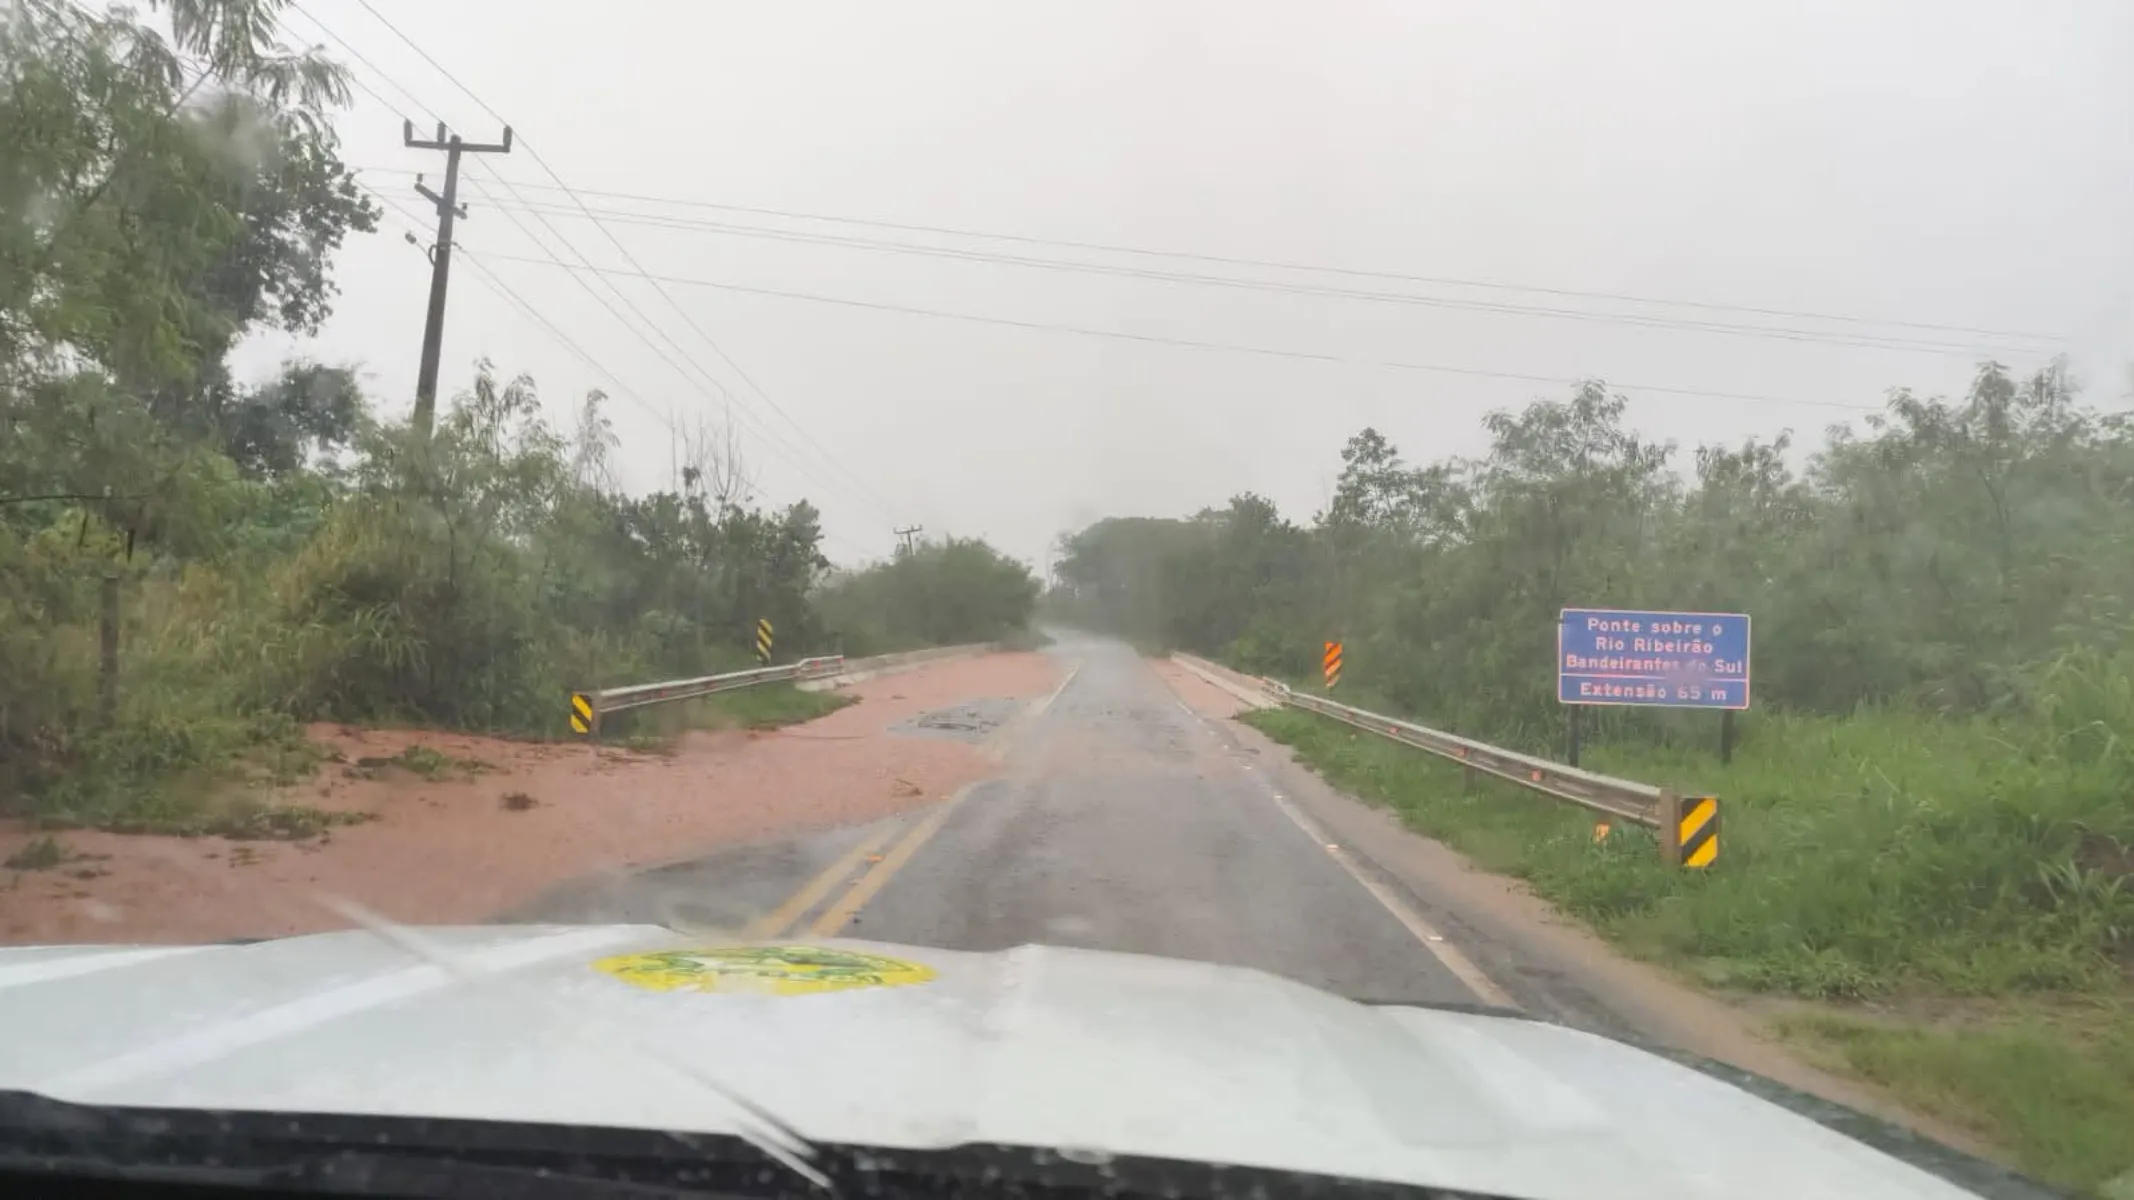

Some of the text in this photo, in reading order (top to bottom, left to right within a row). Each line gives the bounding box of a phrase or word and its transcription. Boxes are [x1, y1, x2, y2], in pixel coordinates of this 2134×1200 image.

[1587, 618, 1723, 636] Ponte sobre o
[1596, 636, 1714, 654] Rio Ribeirão
[1566, 654, 1680, 671] Bandeirantes
[1714, 659, 1743, 673] Sul
[1580, 682, 1727, 700] Extensão 65 m
